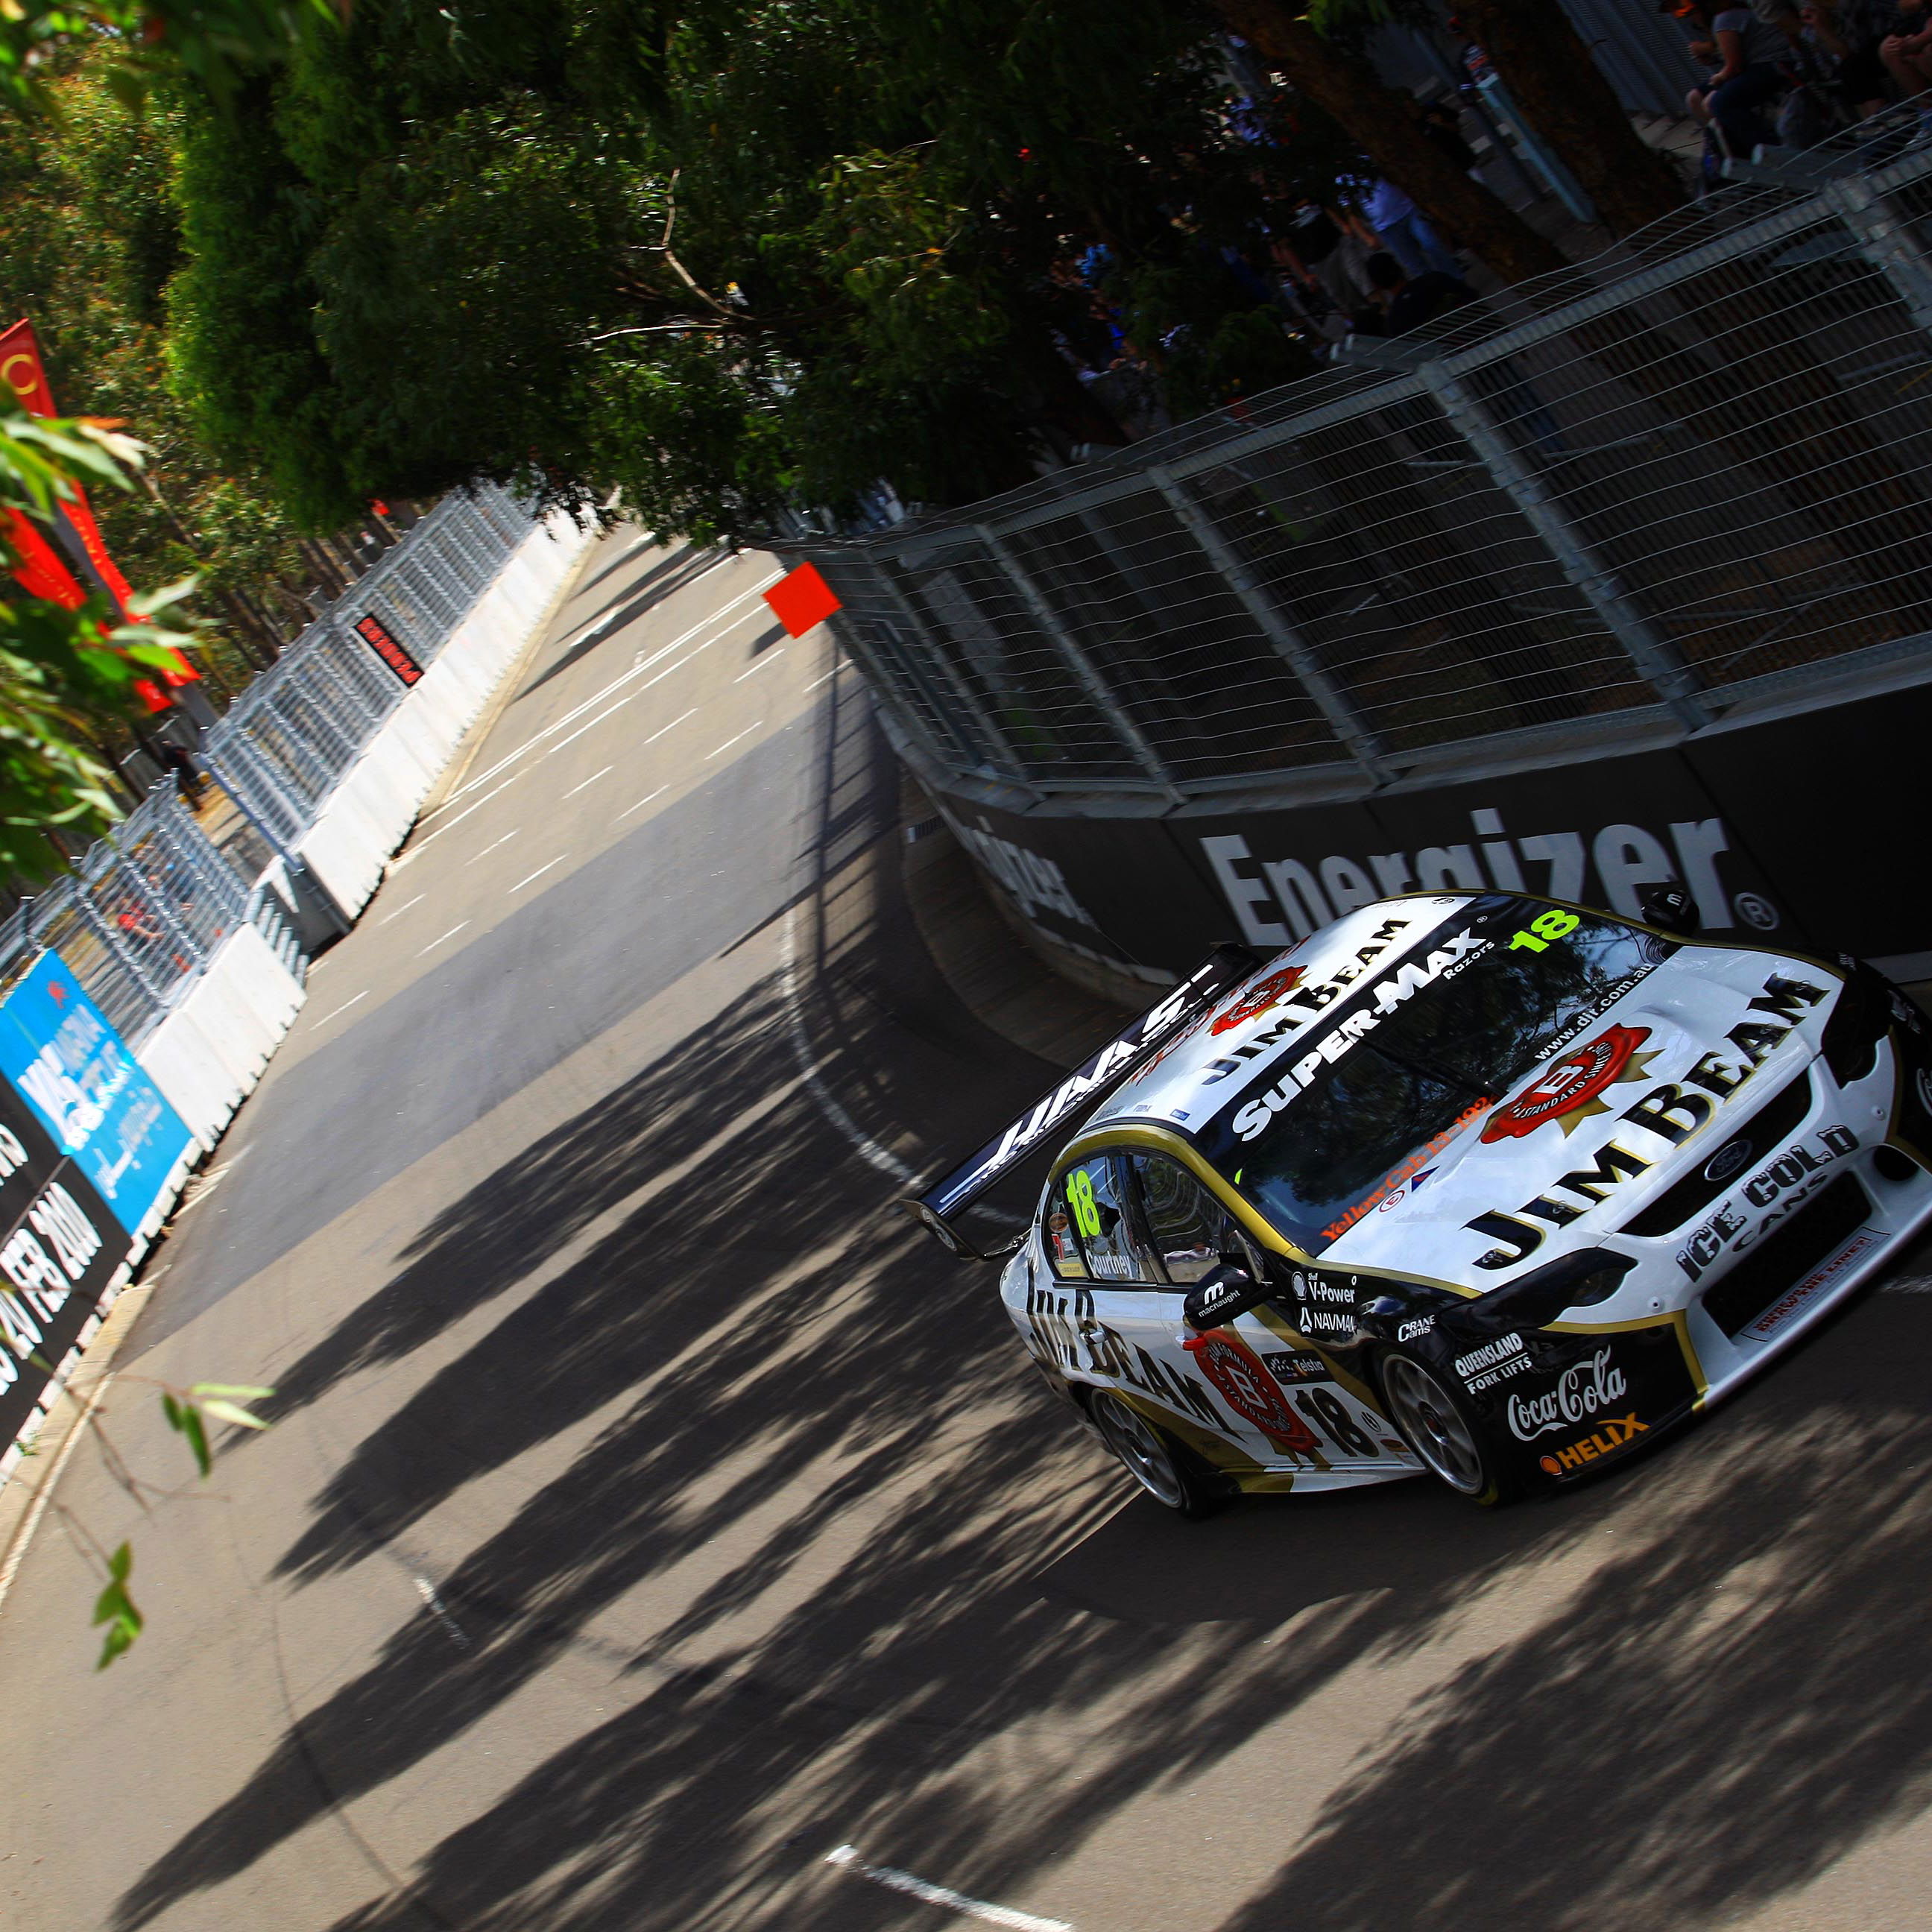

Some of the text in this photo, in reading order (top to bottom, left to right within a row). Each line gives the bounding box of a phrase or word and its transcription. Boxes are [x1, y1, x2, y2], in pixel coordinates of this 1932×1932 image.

[1443, 941, 1495, 980] Razors
[1508, 909, 1580, 953] 18
[1202, 1011, 1307, 1086] JIM
[1281, 918, 1413, 1014] BEAM
[1232, 927, 1486, 1142] SUPER-MAX
[1535, 962, 1656, 1061] www.djr.com.au
[1458, 972, 1830, 1270] JIM BEAM
[1521, 1080, 1586, 1119] STANDARD
[29, 1181, 103, 1281] 2010
[1066, 1170, 1100, 1237] 18
[1319, 1185, 1387, 1241] Yellow
[1385, 1153, 1427, 1190] Cab
[1676, 1199, 1747, 1282] ICE
[1742, 1124, 1860, 1208] COLD
[1732, 1172, 1828, 1252] CANS
[1087, 1249, 1132, 1281] Courtney
[1309, 1281, 1356, 1304] V-Power
[1198, 1289, 1241, 1317] macnaught
[1314, 1312, 1357, 1333] NAVMAN
[1075, 1289, 1247, 1443] BEAM
[1454, 1332, 1524, 1377] QUEENSLAND
[1466, 1356, 1533, 1395] FORK LIFTS
[1294, 1387, 1380, 1458] 18
[1507, 1344, 1627, 1442] Coca-Cola
[1556, 1412, 1652, 1469] HELIX
